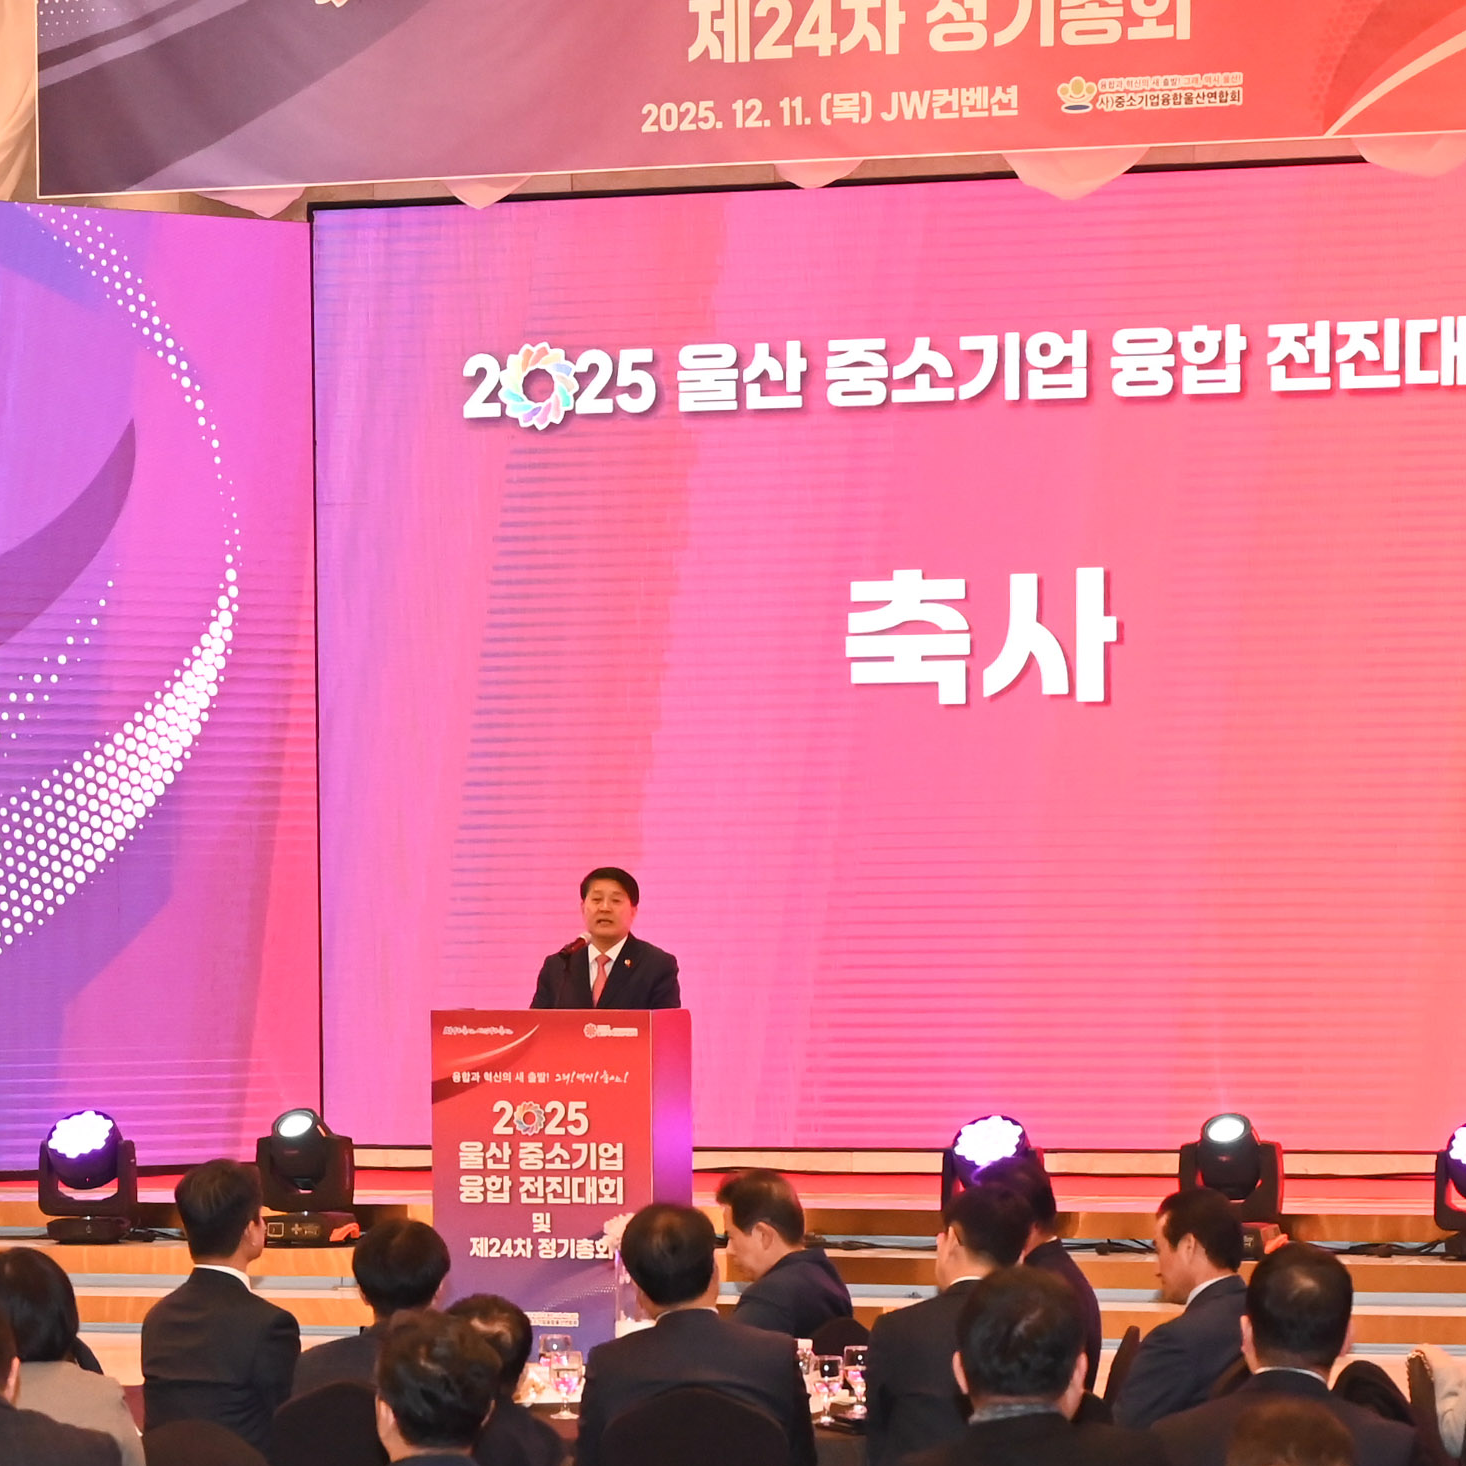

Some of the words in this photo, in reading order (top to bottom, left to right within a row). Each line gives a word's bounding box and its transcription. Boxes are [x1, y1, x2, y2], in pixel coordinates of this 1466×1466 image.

[688, 0, 906, 63] 제24차
[641, 101, 723, 133] 2025.
[732, 98, 771, 129] 12.
[780, 96, 811, 127] 11.
[820, 91, 872, 126] (목)
[880, 85, 1018, 122] JW컨벤션
[462, 341, 657, 430] 2025
[676, 340, 808, 413] 울산
[825, 329, 1089, 408] 중소기업
[1110, 323, 1247, 398] 융합
[845, 566, 1118, 705] 축사
[452, 1071, 481, 1084] 융합과
[483, 1071, 513, 1084] 혁신의
[514, 1071, 525, 1084] 새
[492, 1100, 589, 1136] 2025
[458, 1141, 512, 1171] 울산
[518, 1141, 624, 1171] 중소기업
[458, 1174, 512, 1205] 융합
[518, 1175, 624, 1205] 전진대회
[532, 1212, 552, 1233] 및
[469, 1236, 533, 1260] 제24차
[537, 1236, 614, 1260] 정기총회
